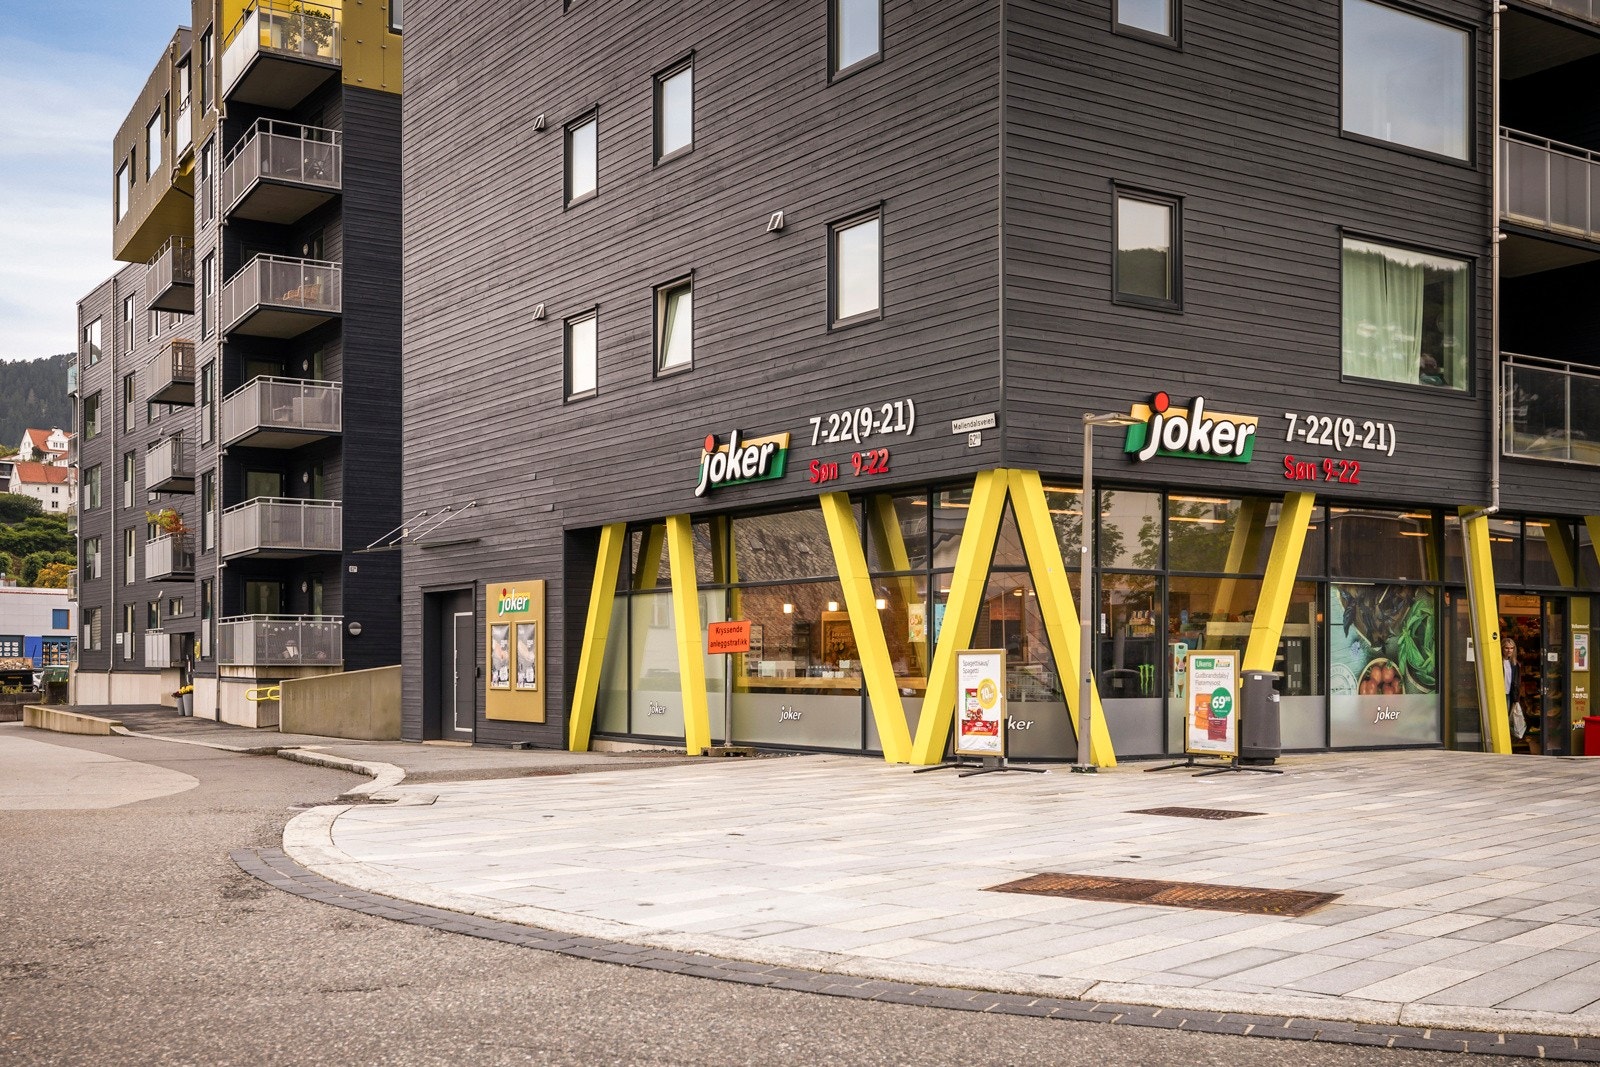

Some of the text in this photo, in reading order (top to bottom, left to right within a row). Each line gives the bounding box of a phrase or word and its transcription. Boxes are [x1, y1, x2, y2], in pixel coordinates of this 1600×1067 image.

[809, 399, 916, 446] 7-22(9-21)
[1137, 391, 1256, 462] joker
[1284, 412, 1397, 457] 7-22(9-21)
[694, 429, 776, 497] joker
[809, 448, 889, 484] Søn 9-22
[1284, 455, 1361, 484] Søn 9-22
[499, 588, 528, 616] joker
[710, 639, 747, 648] anleggstrafikk
[715, 626, 743, 636] Kryssende
[647, 700, 666, 716] joker
[778, 705, 802, 723] joker
[1373, 706, 1401, 724] joker
[1007, 715, 1034, 730] ker
